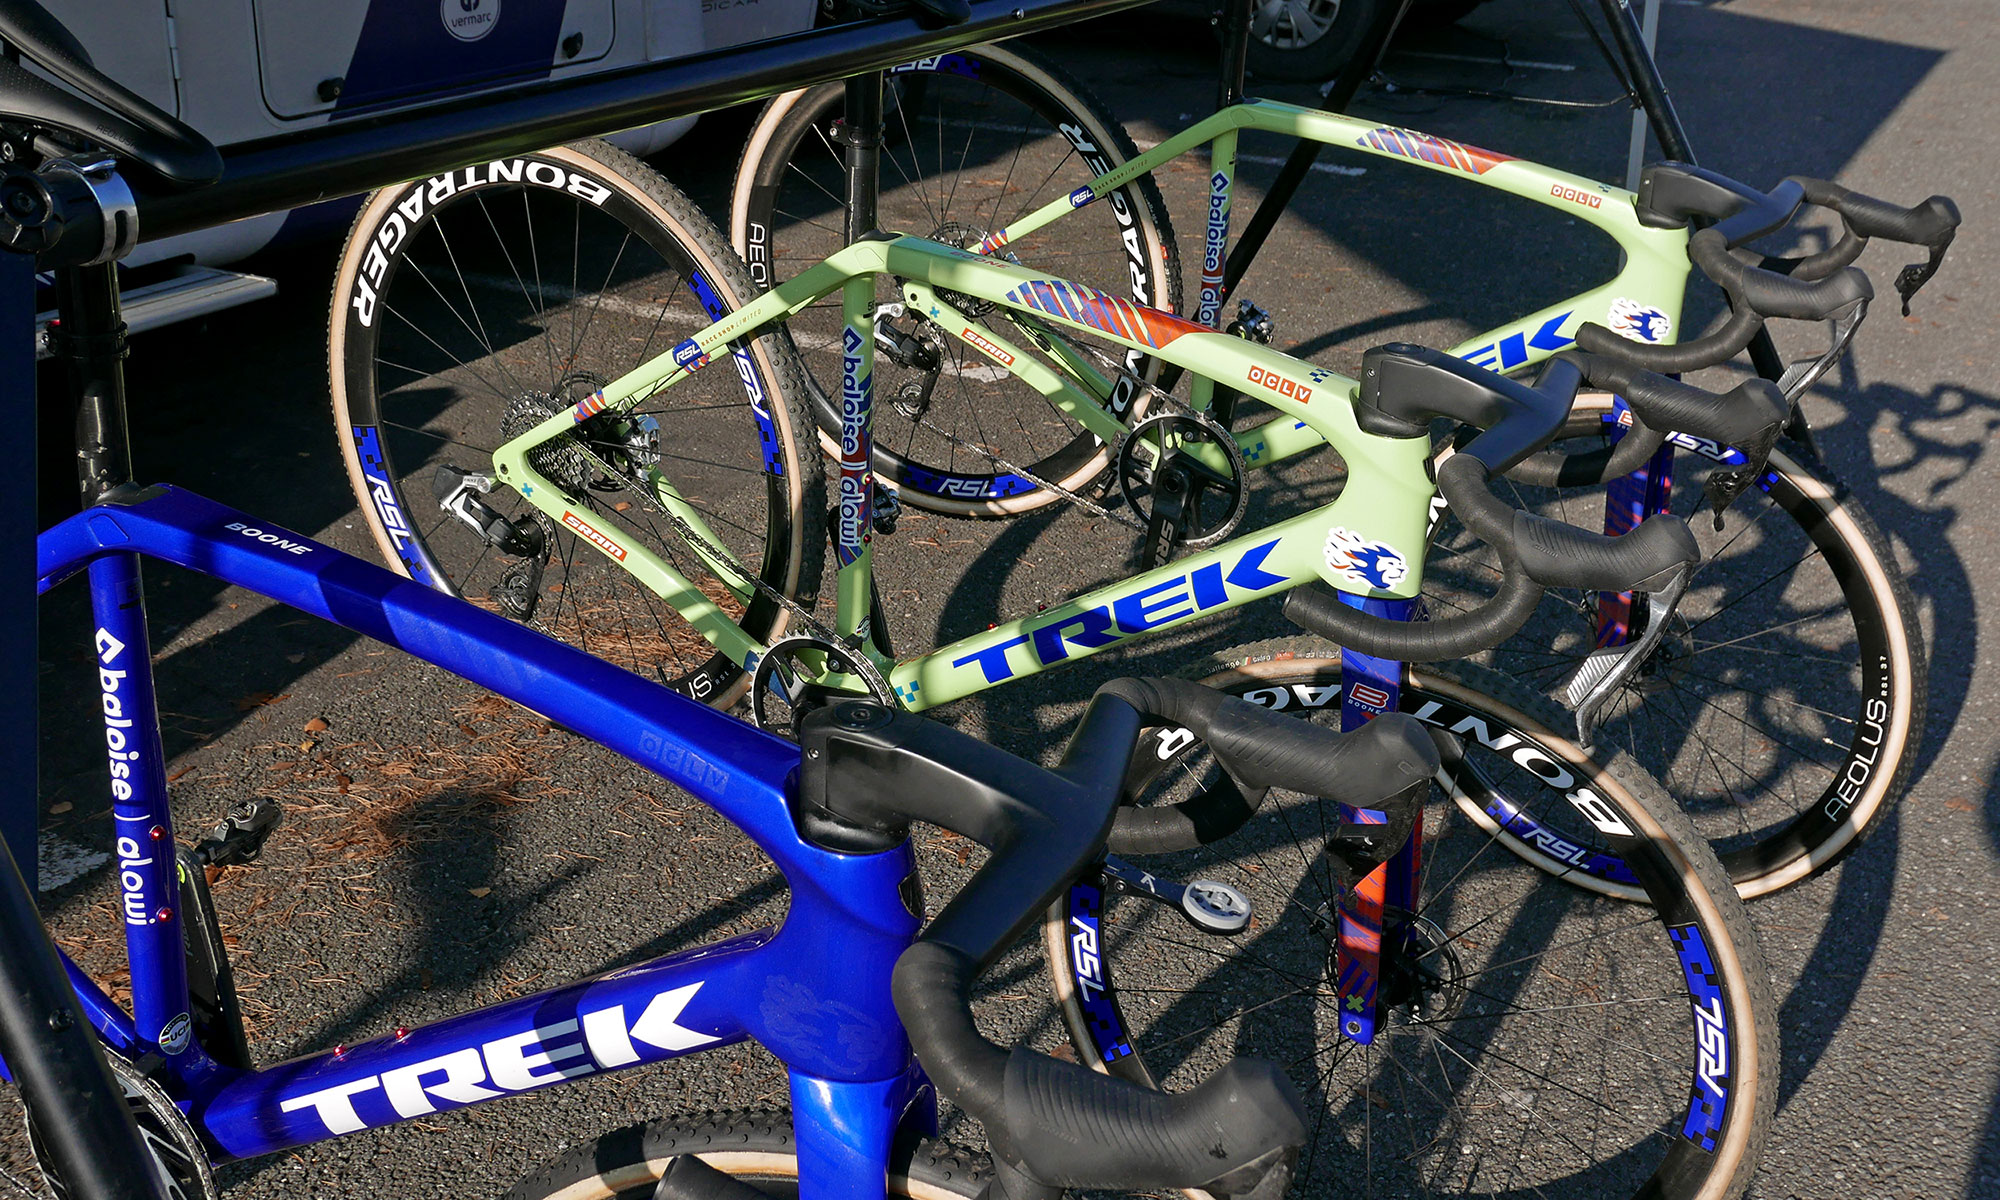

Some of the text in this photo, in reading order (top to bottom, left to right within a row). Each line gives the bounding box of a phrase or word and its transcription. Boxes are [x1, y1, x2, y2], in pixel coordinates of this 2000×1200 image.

[451, 12, 492, 28] vermarc
[1072, 190, 1093, 206] RSL
[1551, 184, 1601, 208] OCLV
[353, 159, 613, 328] BONTRAGER
[1205, 194, 1227, 271] baloise
[949, 250, 1010, 268] BOONE
[676, 308, 762, 364] RSL RACE SHOP LIMITED
[963, 330, 1012, 363] SRAM
[1249, 368, 1311, 402] OCLV
[840, 355, 866, 547] baloise glowi
[938, 478, 998, 498] RSL
[366, 474, 411, 551] RSL
[224, 522, 314, 555] BOONE
[564, 515, 624, 558] SRAM
[952, 537, 1291, 684] TREK
[715, 670, 730, 686] RSL
[1880, 675, 1889, 697] RSL
[1347, 698, 1382, 715] BOONE
[640, 732, 729, 794] OCLV
[1824, 698, 1888, 822] AEOLUS
[99, 665, 158, 926] baloise glowi
[1523, 827, 1591, 869] RSL
[1071, 915, 1105, 1003] RSL
[170, 1025, 186, 1042] UCI
[1694, 996, 1726, 1099] RSL
[280, 981, 722, 1135] TREK
